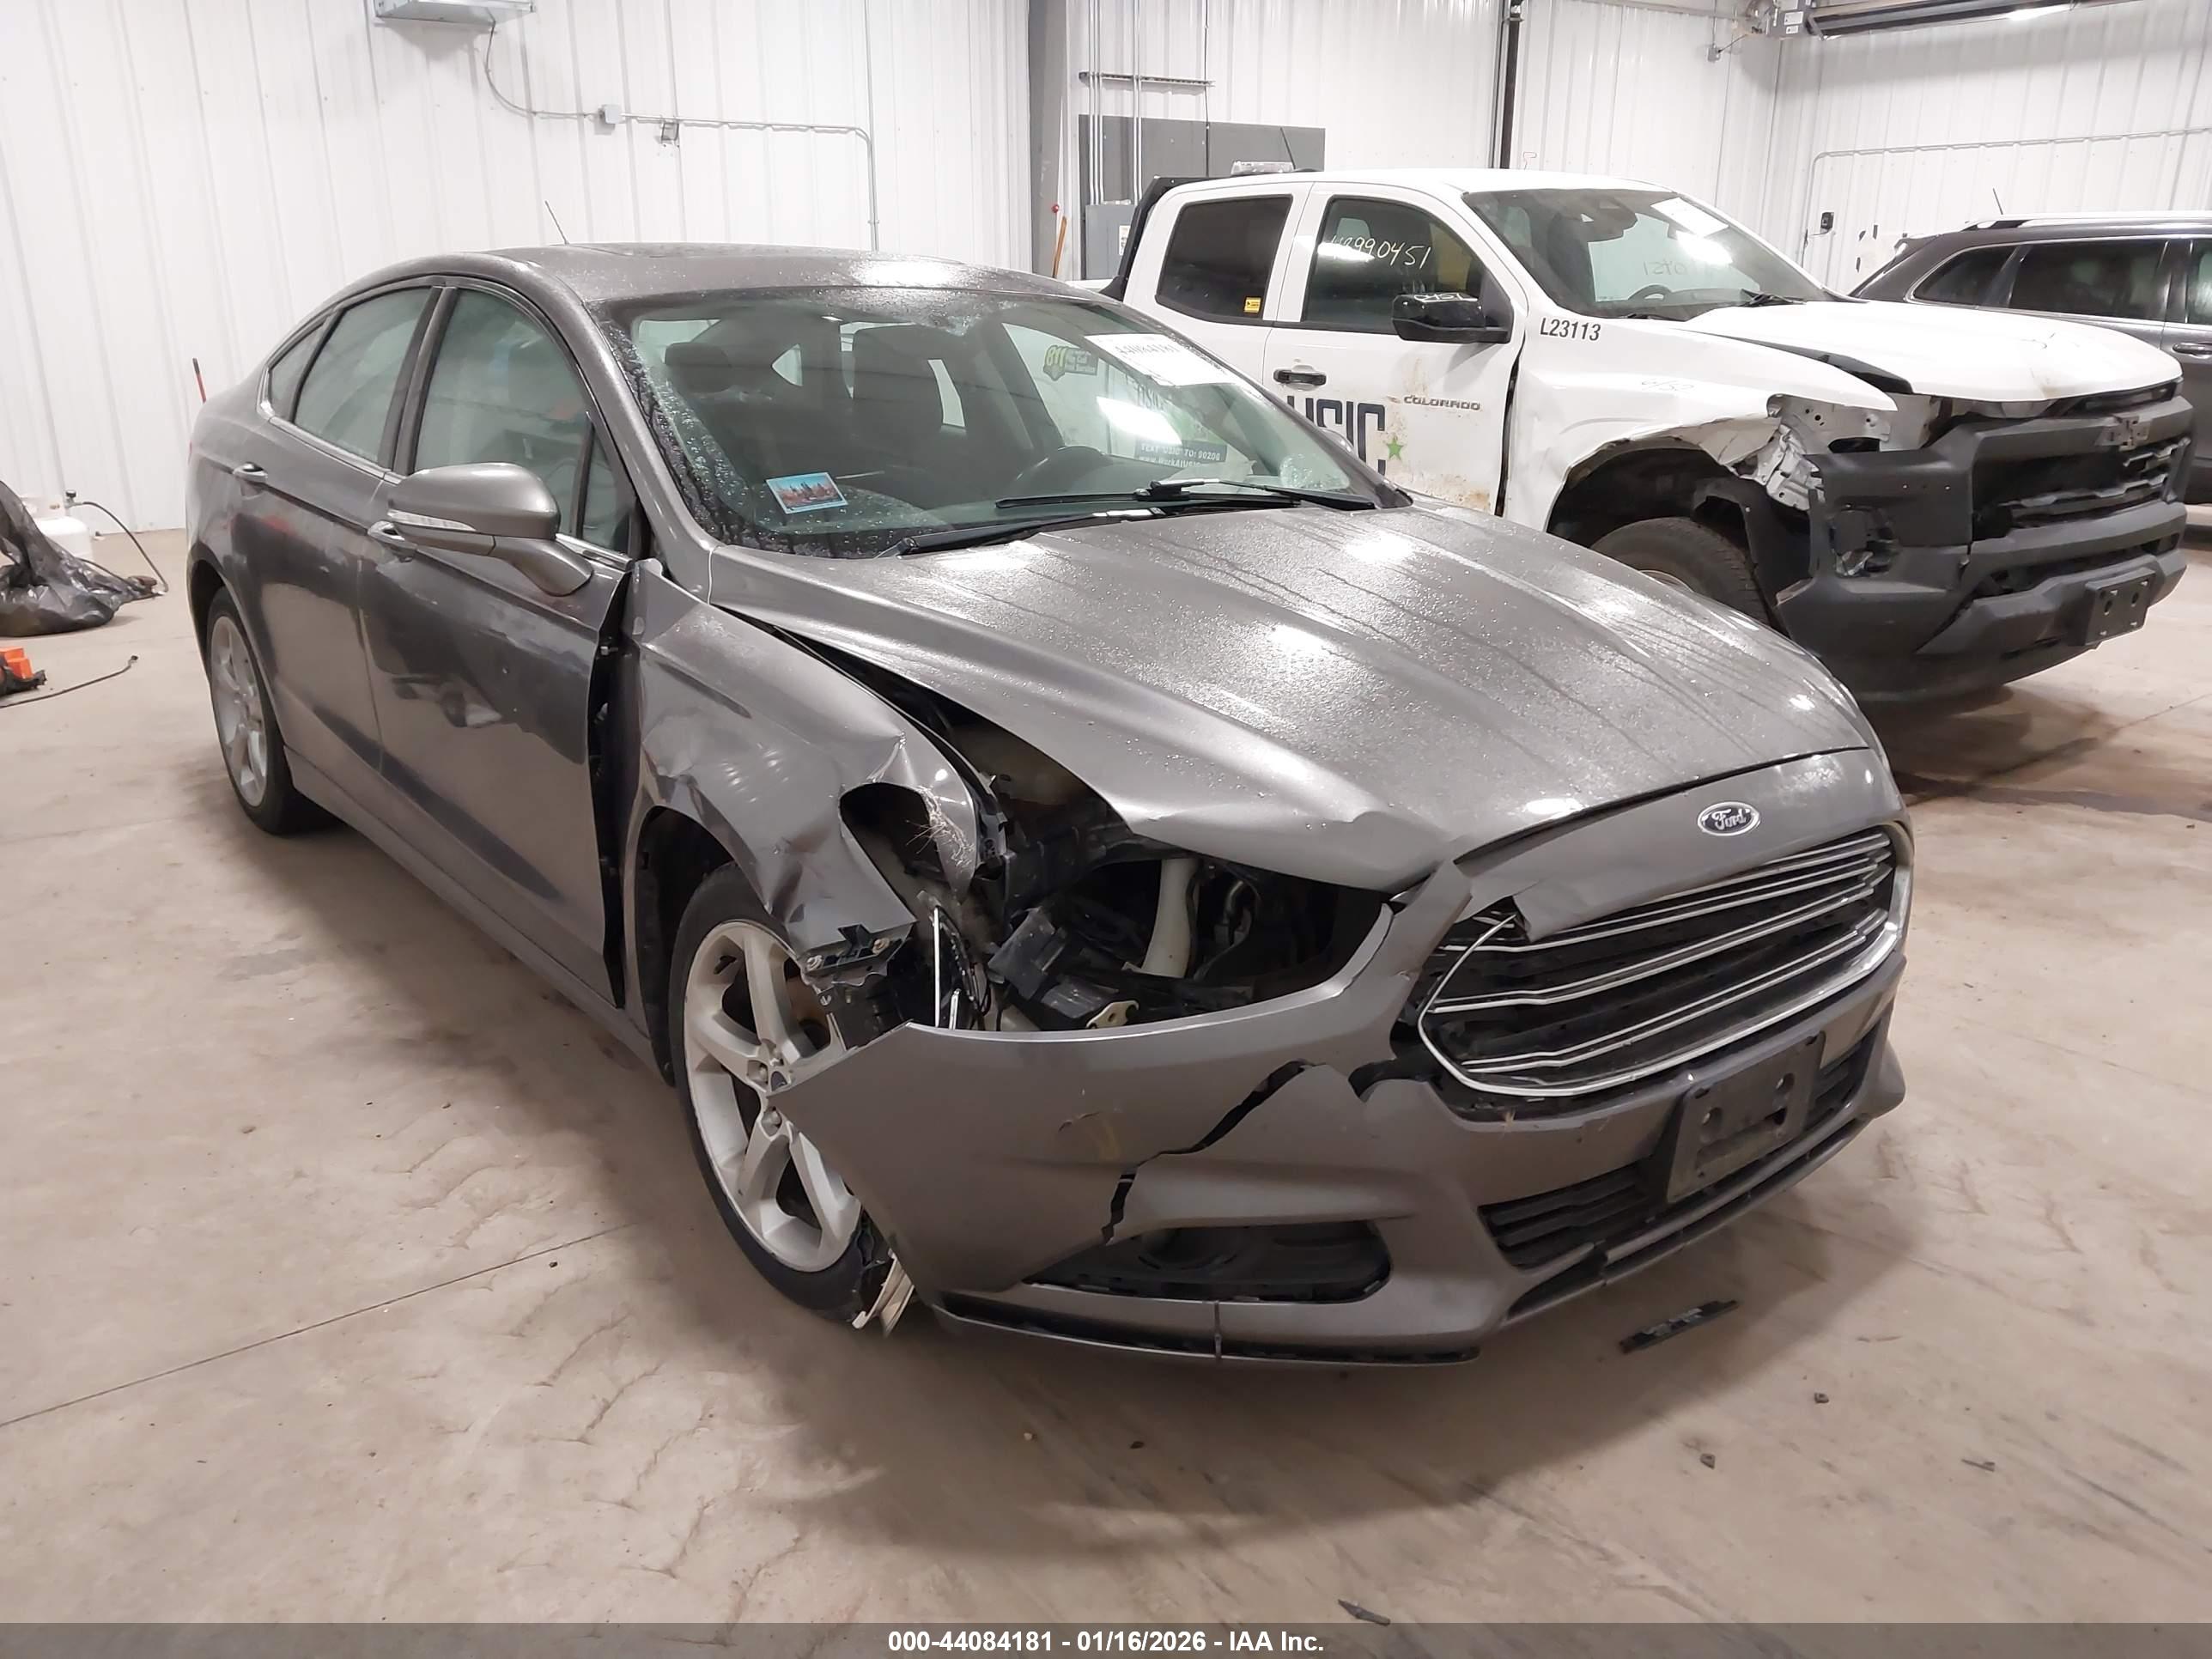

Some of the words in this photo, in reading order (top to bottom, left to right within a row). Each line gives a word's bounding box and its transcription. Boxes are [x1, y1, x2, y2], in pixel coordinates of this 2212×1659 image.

[1540, 317, 1601, 341] L23113
[1403, 394, 1481, 410] COLORADO
[1711, 808, 1749, 830] Ford
